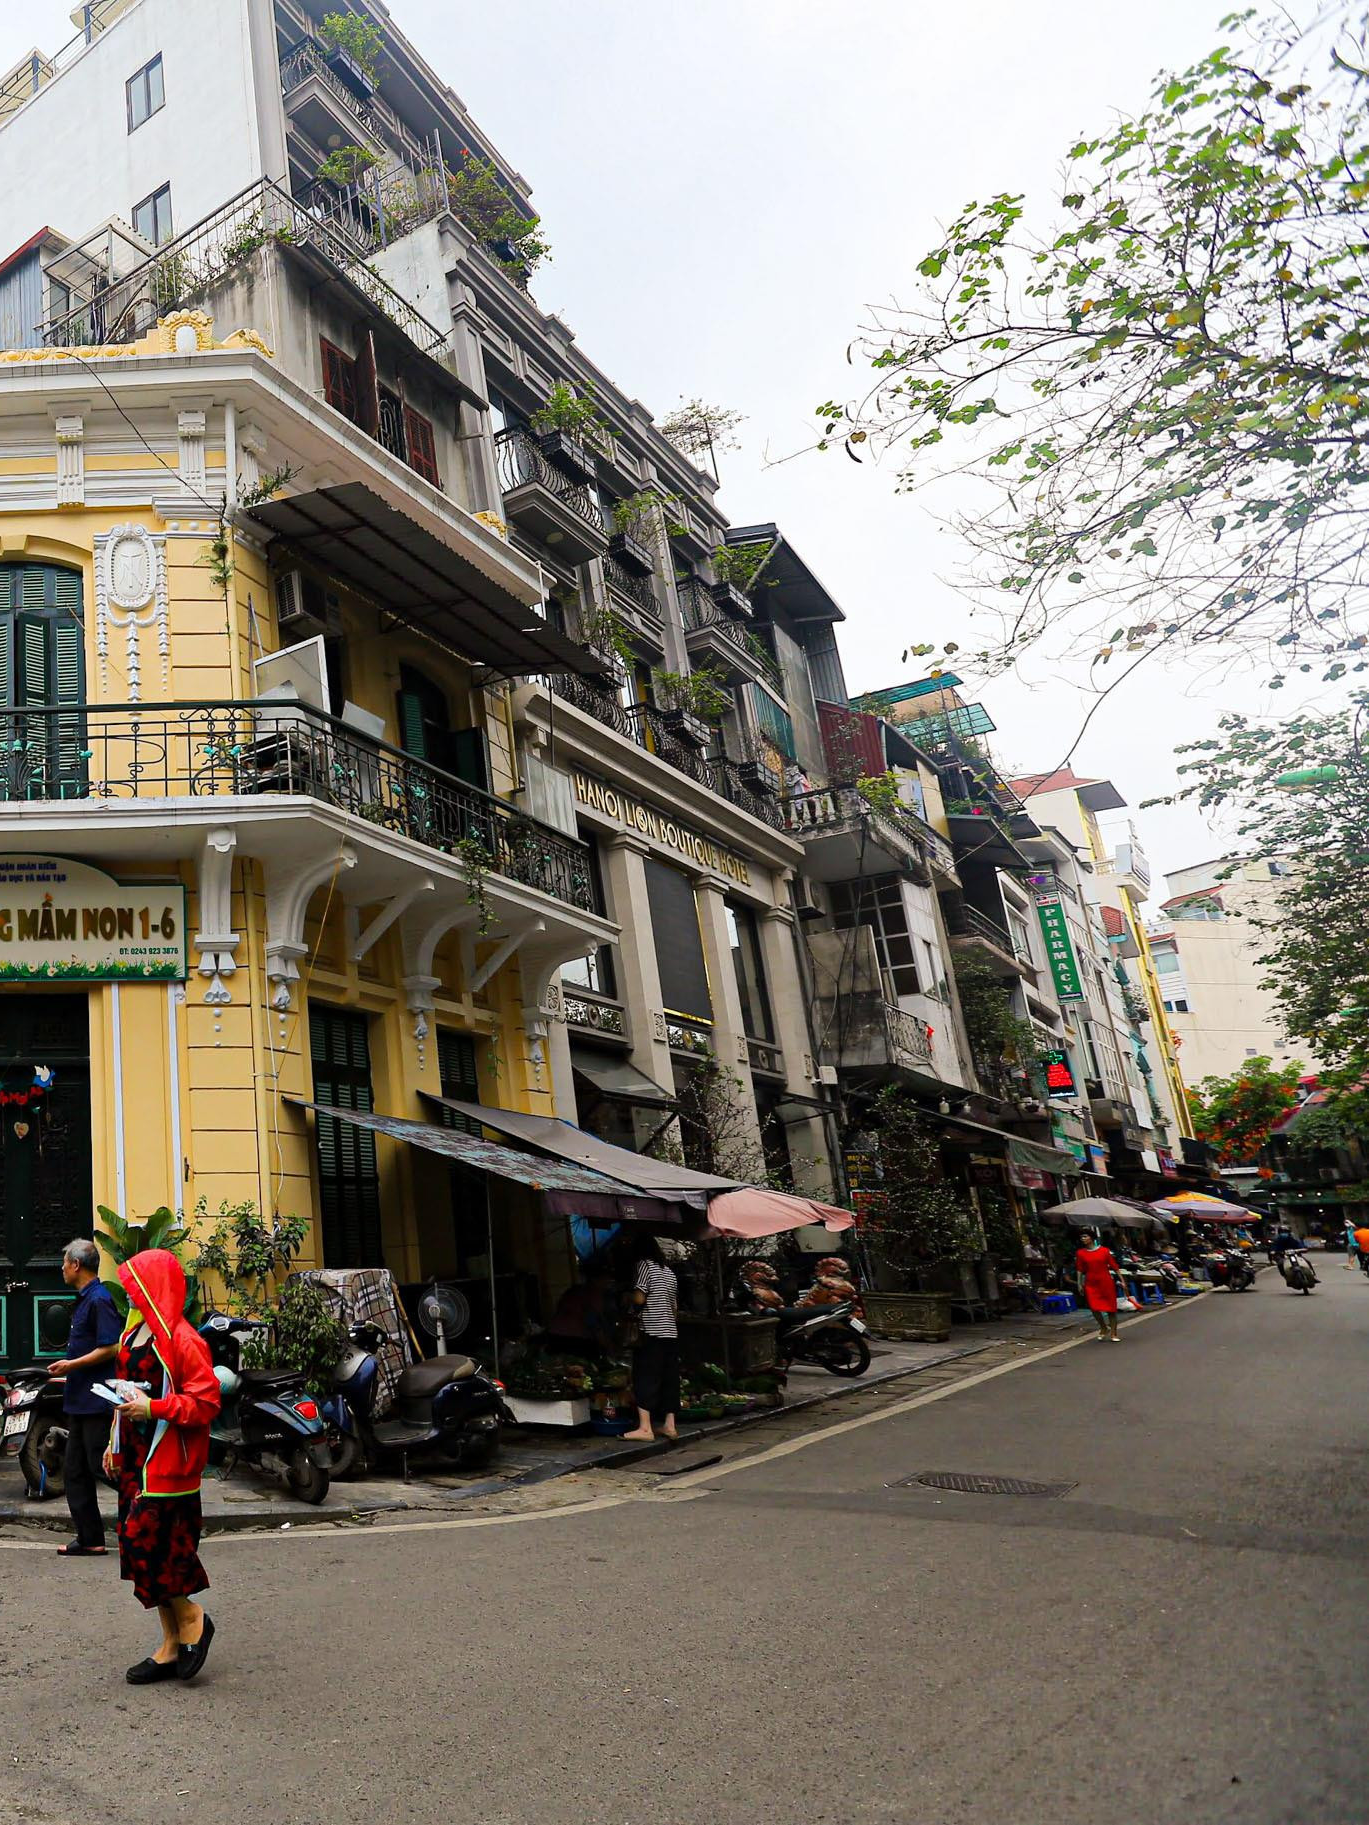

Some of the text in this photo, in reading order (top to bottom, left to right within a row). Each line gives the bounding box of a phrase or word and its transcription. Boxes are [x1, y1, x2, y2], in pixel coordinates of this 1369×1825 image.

[575, 774, 752, 887] HANOI LION BOUTIQUE HOTEL
[17, 893, 78, 942] MẦM
[81, 907, 134, 942] NON
[138, 906, 176, 942] 1-6
[1044, 908, 1074, 993] PHARMACY
